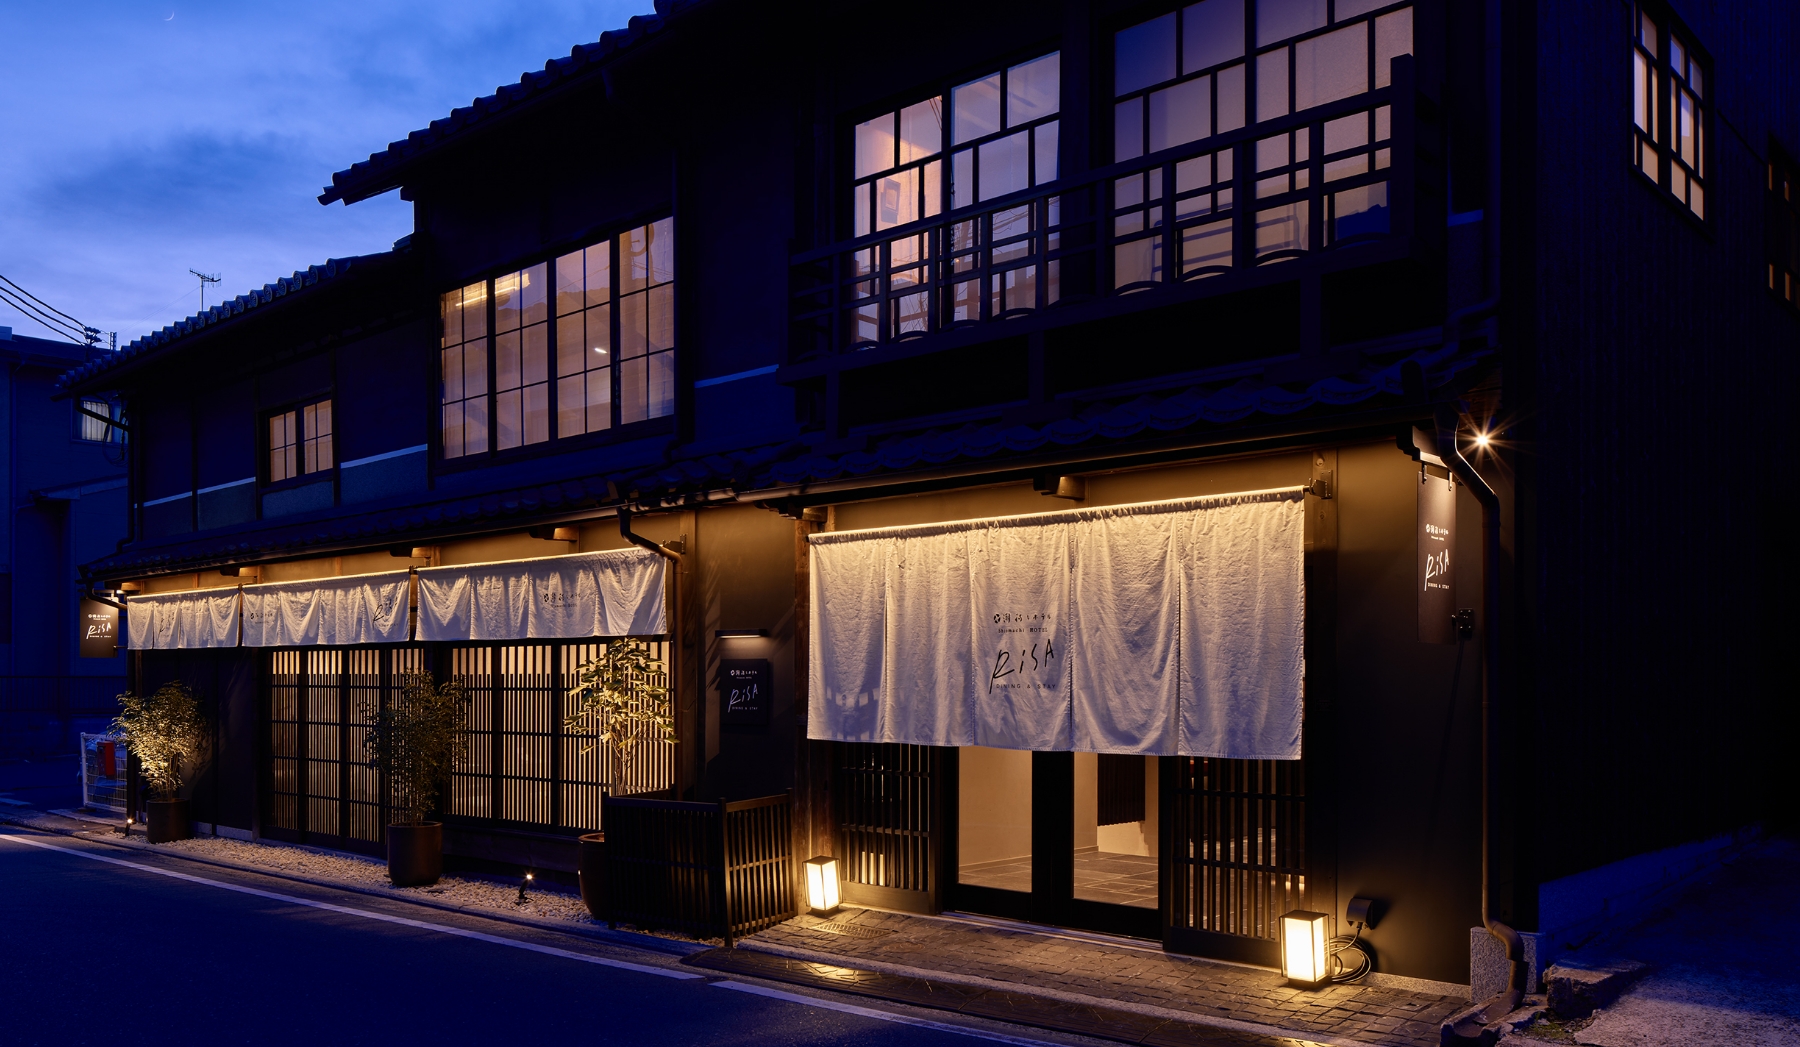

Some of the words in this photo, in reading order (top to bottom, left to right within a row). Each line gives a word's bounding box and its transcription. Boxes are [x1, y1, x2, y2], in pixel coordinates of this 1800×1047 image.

[1424, 548, 1450, 592] RiSA
[989, 638, 1055, 695] RiSA
[727, 683, 759, 713] RiSA
